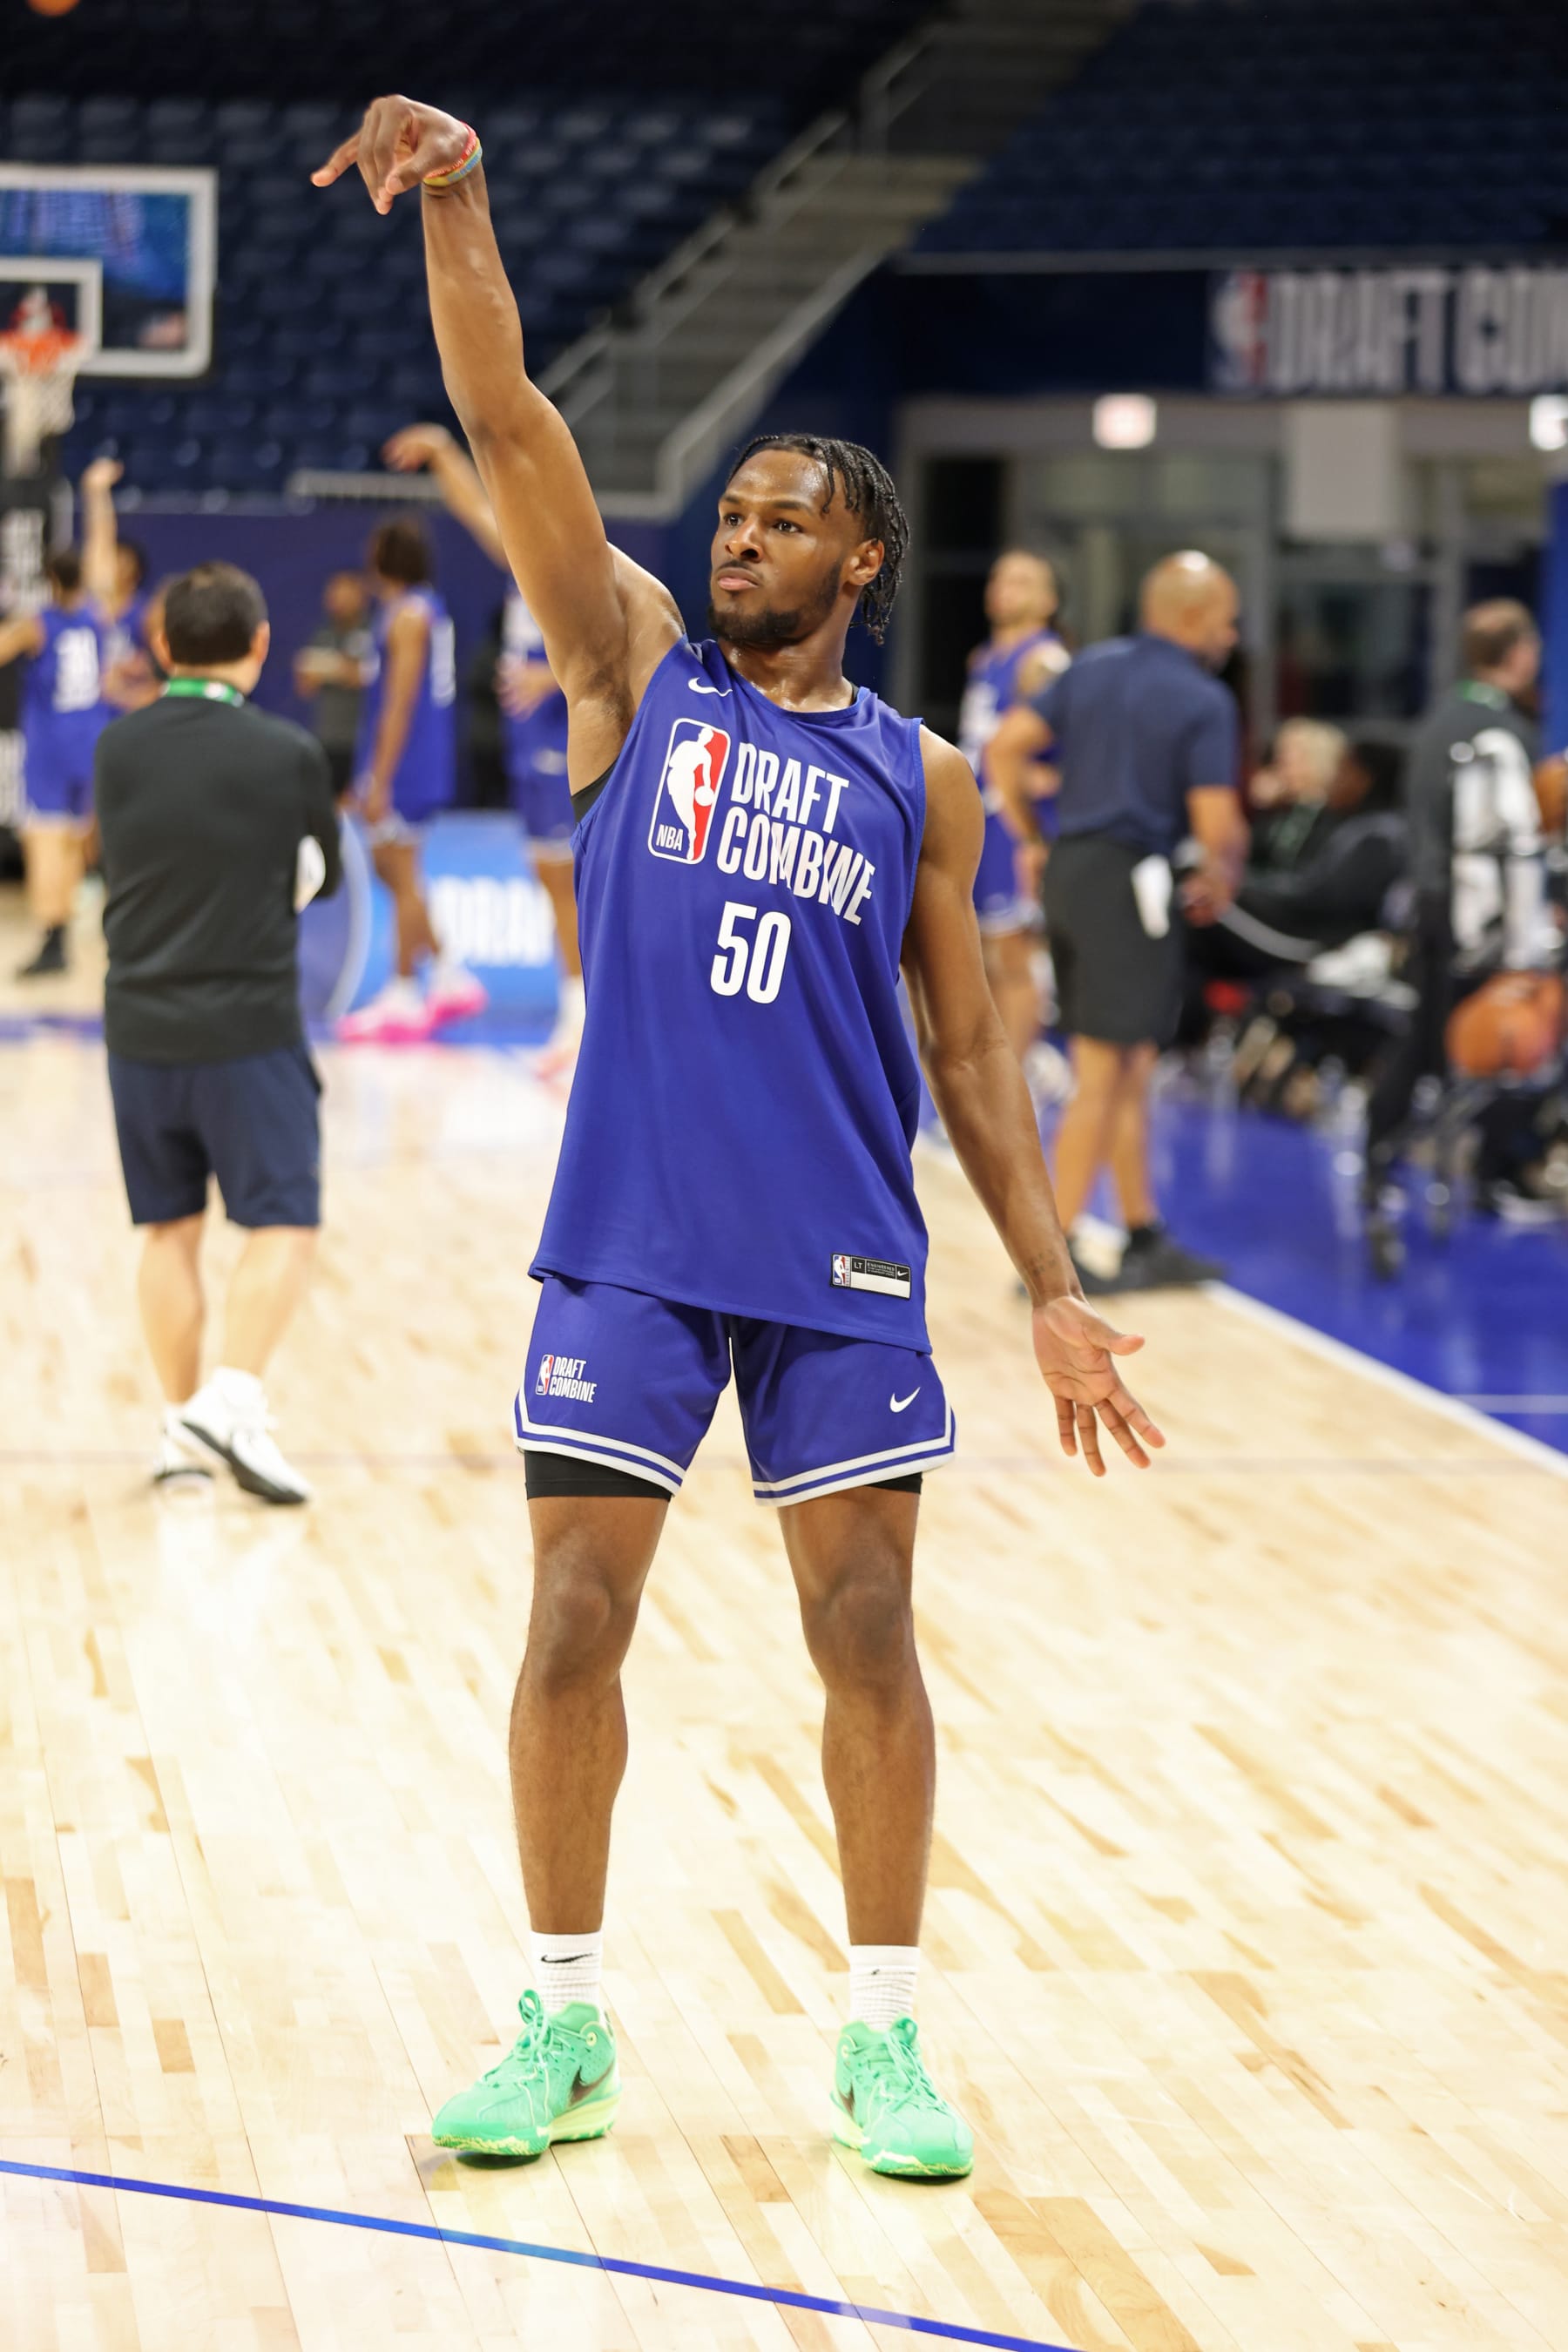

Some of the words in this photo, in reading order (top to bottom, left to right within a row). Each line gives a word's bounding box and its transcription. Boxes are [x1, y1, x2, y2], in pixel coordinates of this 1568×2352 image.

[1271, 272, 1449, 389] DRAFT
[730, 742, 849, 833] DRAFT
[656, 824, 683, 852] NBA
[716, 806, 875, 926] COMBINE
[710, 901, 792, 1004] 50
[549, 1376, 597, 1402] COMBINE
[552, 1356, 586, 1379] DRAFT
